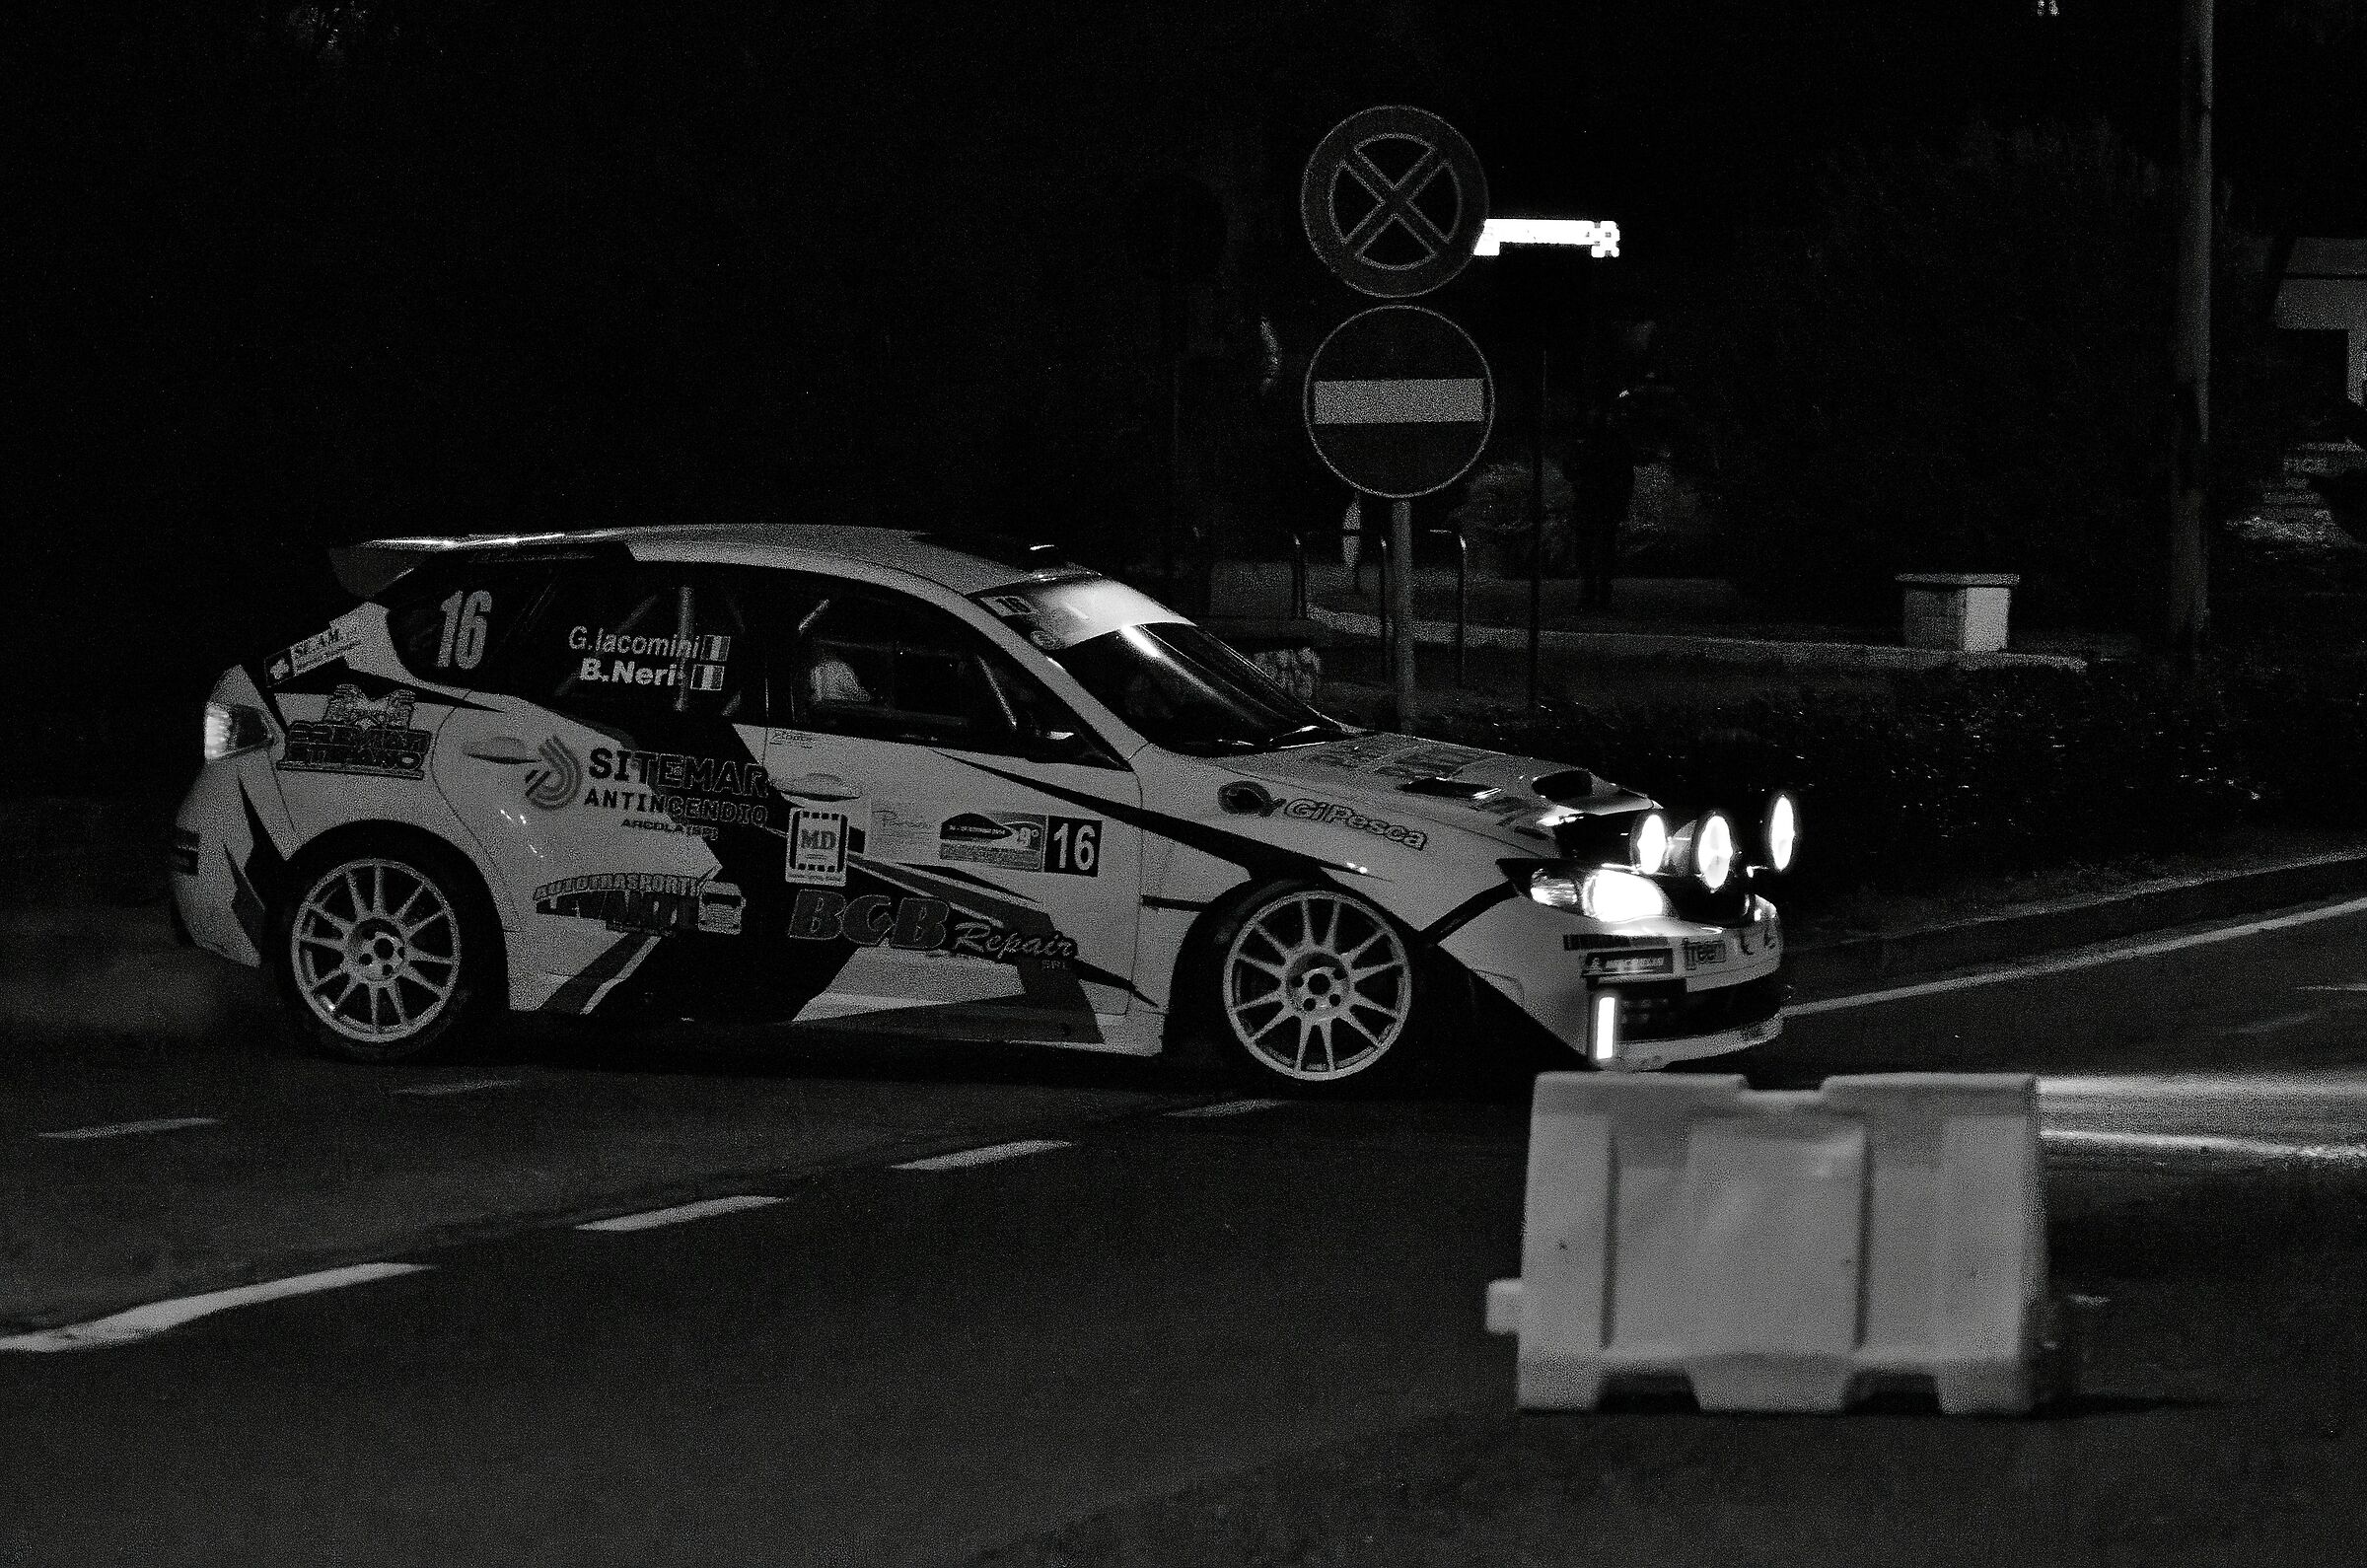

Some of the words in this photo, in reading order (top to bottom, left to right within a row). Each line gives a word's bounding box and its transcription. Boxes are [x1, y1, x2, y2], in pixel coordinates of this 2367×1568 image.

[437, 590, 492, 671] 16
[589, 747, 770, 799] SITEMAR
[584, 787, 769, 825] ANTINCENDIO
[1284, 797, 1428, 851] GiPesca
[800, 829, 837, 851] MD
[1052, 821, 1096, 872] 16
[533, 873, 700, 900] AUTOTRASPORTI
[952, 920, 1078, 960] Repair
